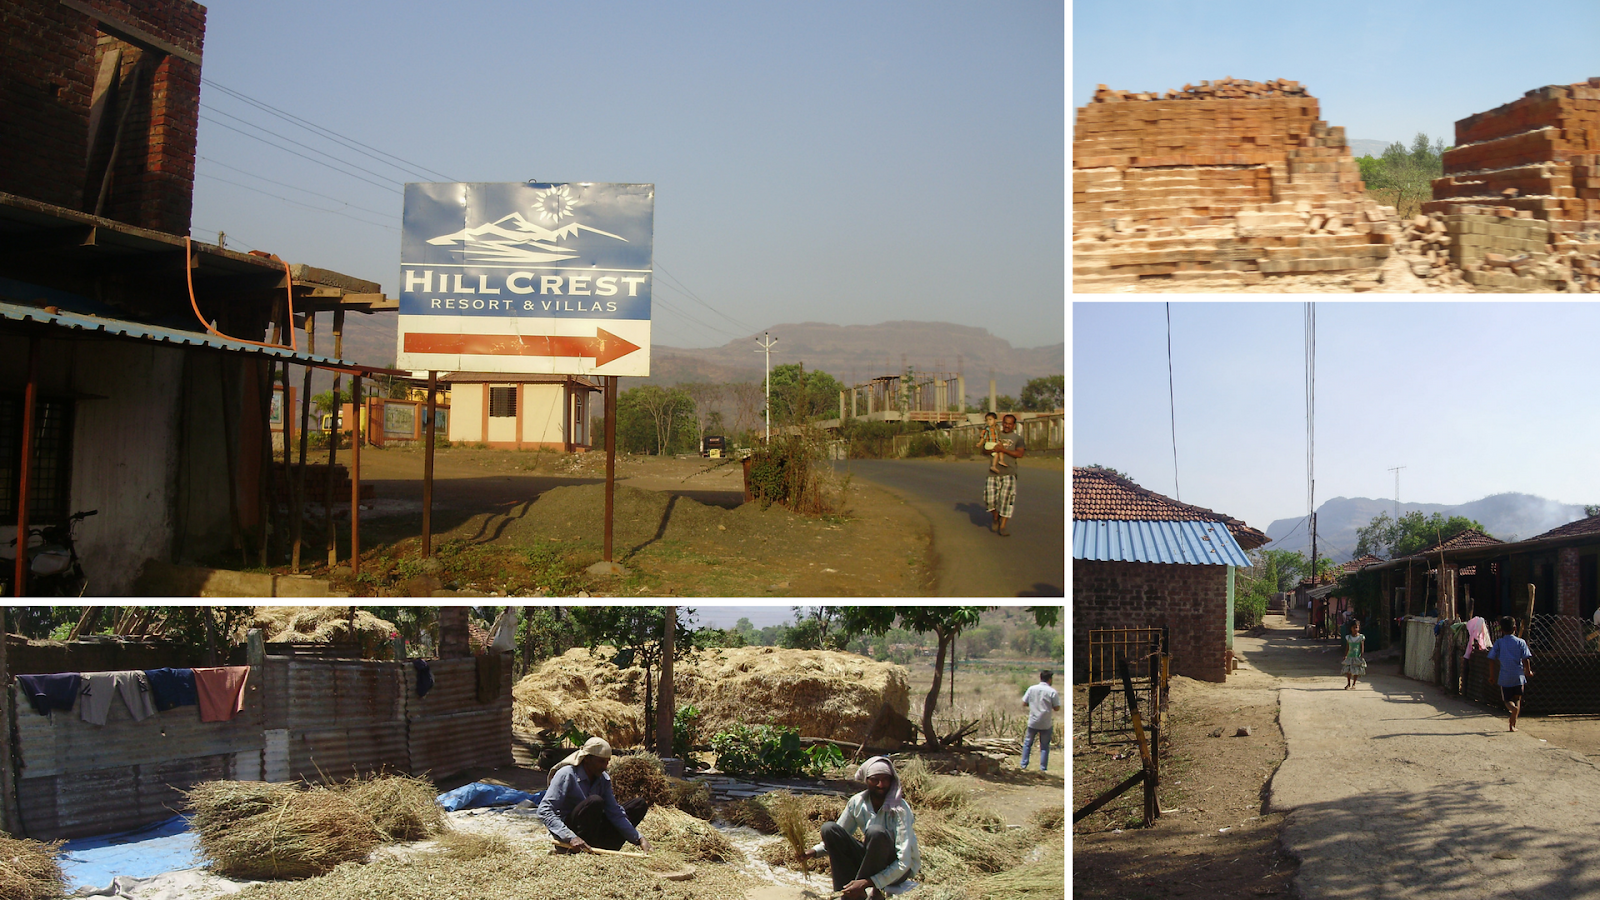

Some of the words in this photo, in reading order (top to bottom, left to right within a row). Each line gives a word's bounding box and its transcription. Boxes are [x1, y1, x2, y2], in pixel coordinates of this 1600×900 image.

[431, 298, 513, 310] RESORT
[523, 300, 534, 311] &
[541, 300, 617, 312] VILLAS
